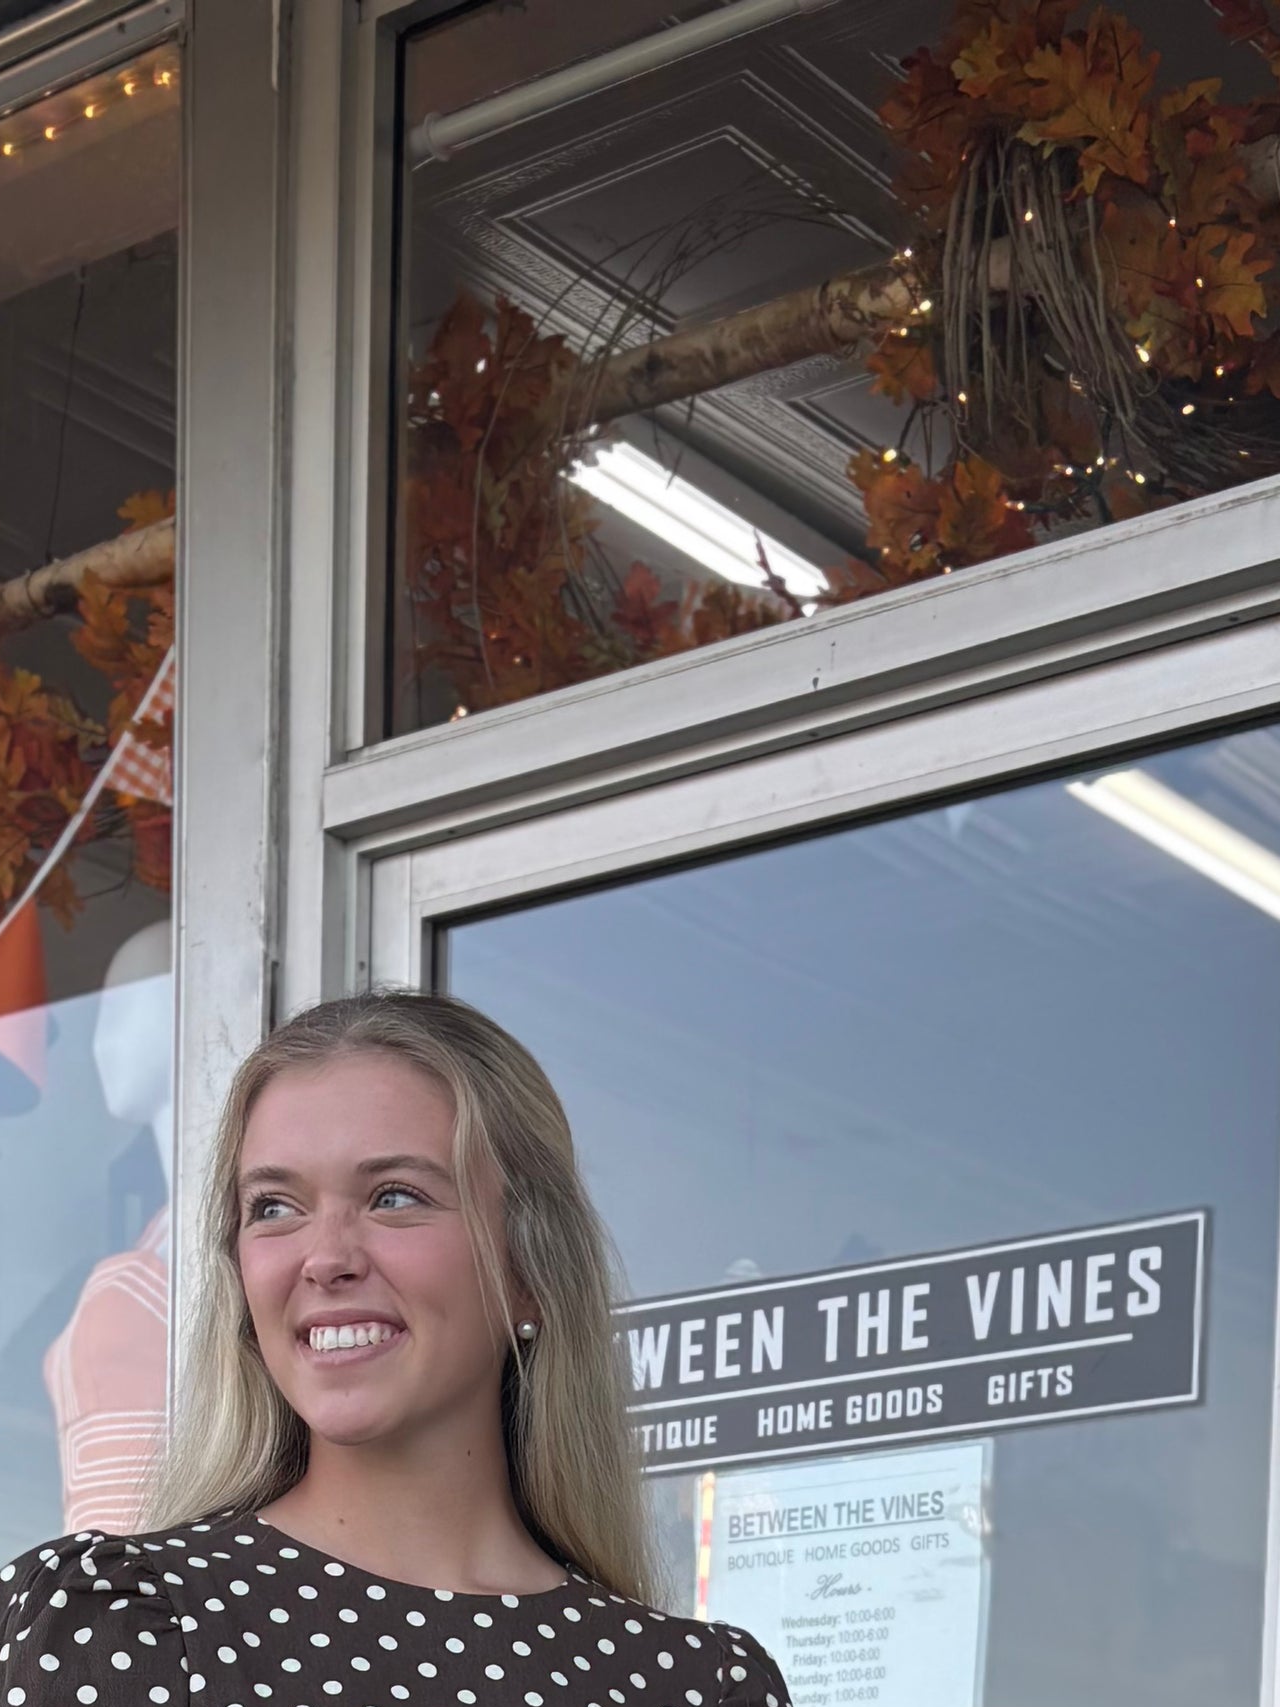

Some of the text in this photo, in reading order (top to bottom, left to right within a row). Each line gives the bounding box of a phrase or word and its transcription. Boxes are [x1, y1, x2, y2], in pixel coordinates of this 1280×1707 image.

[615, 1245, 1164, 1392] WEEN THE VINES
[631, 1365, 1074, 1453] TIQUE HOME GOODS GIFTS
[728, 1490, 945, 1539] BETWEEN THE VINES
[727, 1532, 950, 1571] BOUTIQUE HOME GOODS GIFTS
[781, 1613, 842, 1630] Wednesday:
[786, 1632, 836, 1649] Thursday:
